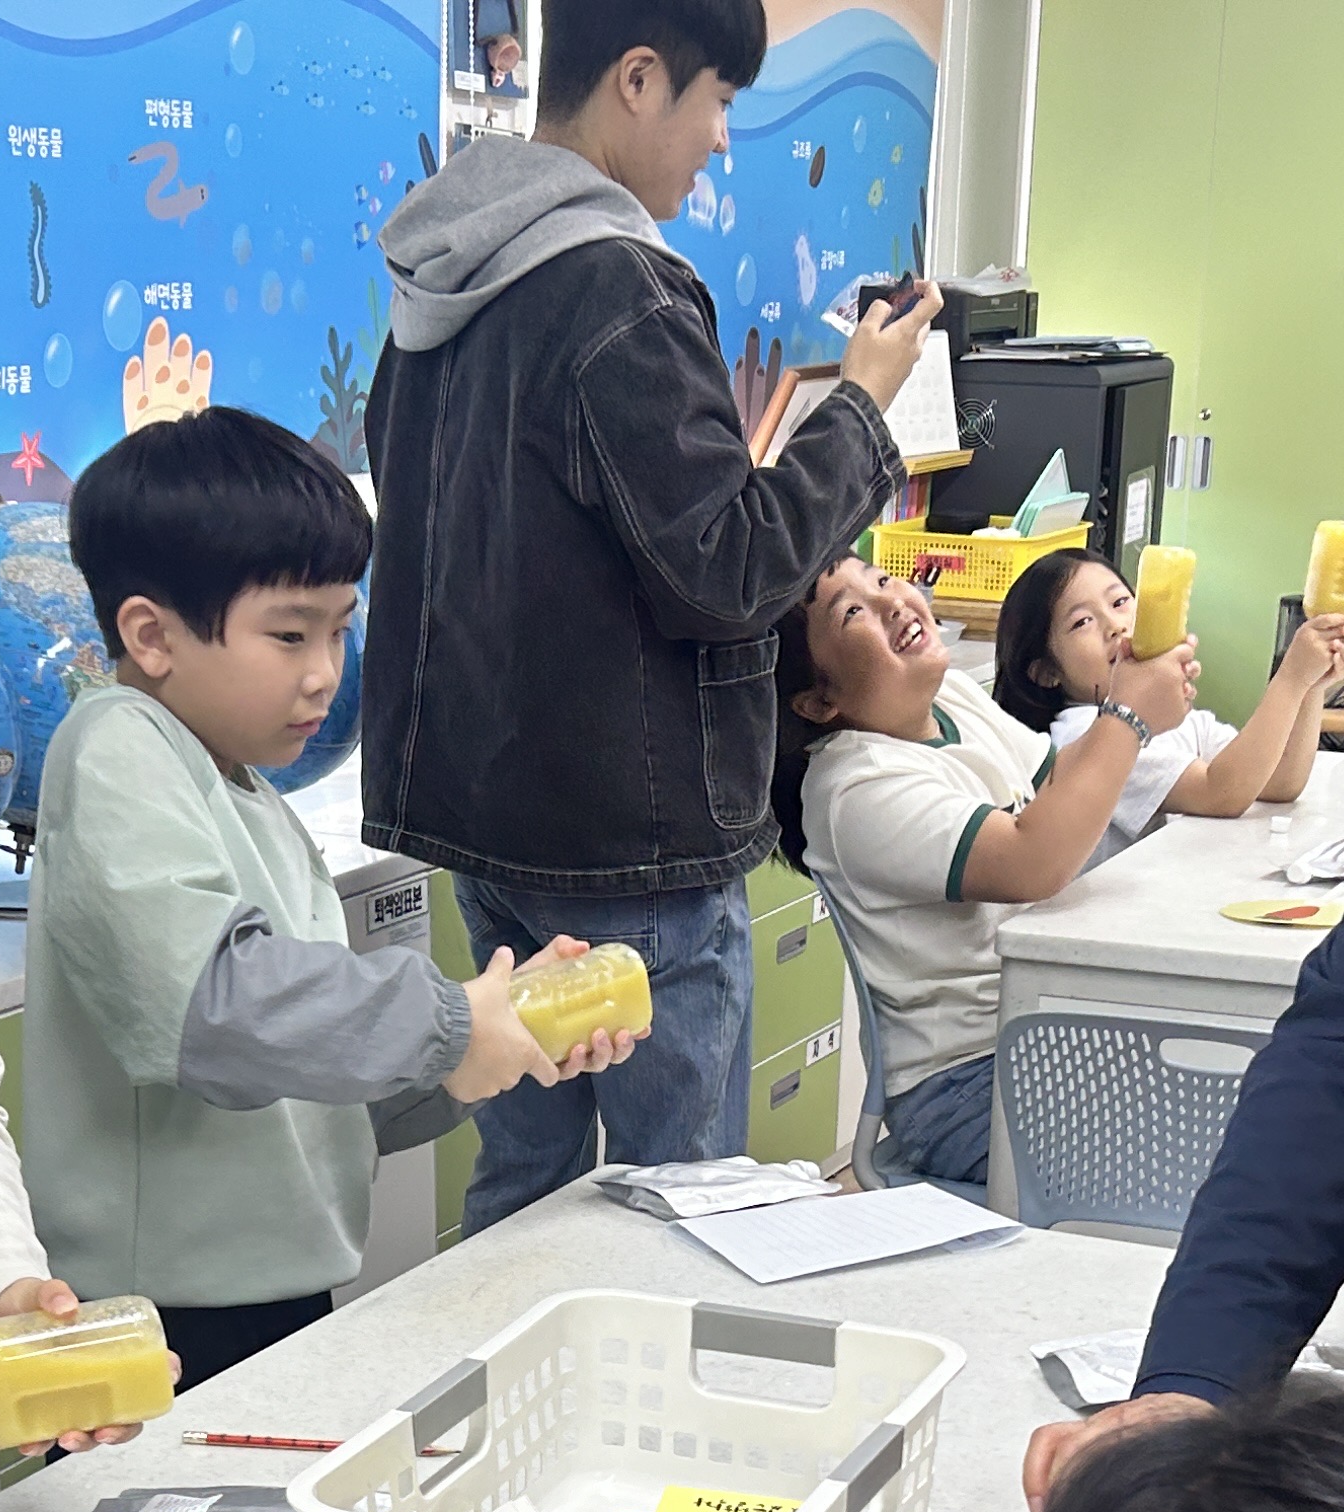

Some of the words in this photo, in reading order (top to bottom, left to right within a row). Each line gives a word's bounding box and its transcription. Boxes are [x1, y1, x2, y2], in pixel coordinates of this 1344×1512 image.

[144, 98, 193, 129] 편형동물
[7, 124, 64, 158] 원생동물
[143, 282, 193, 310] 해면동물
[374, 884, 423, 923] 퇴적암표본
